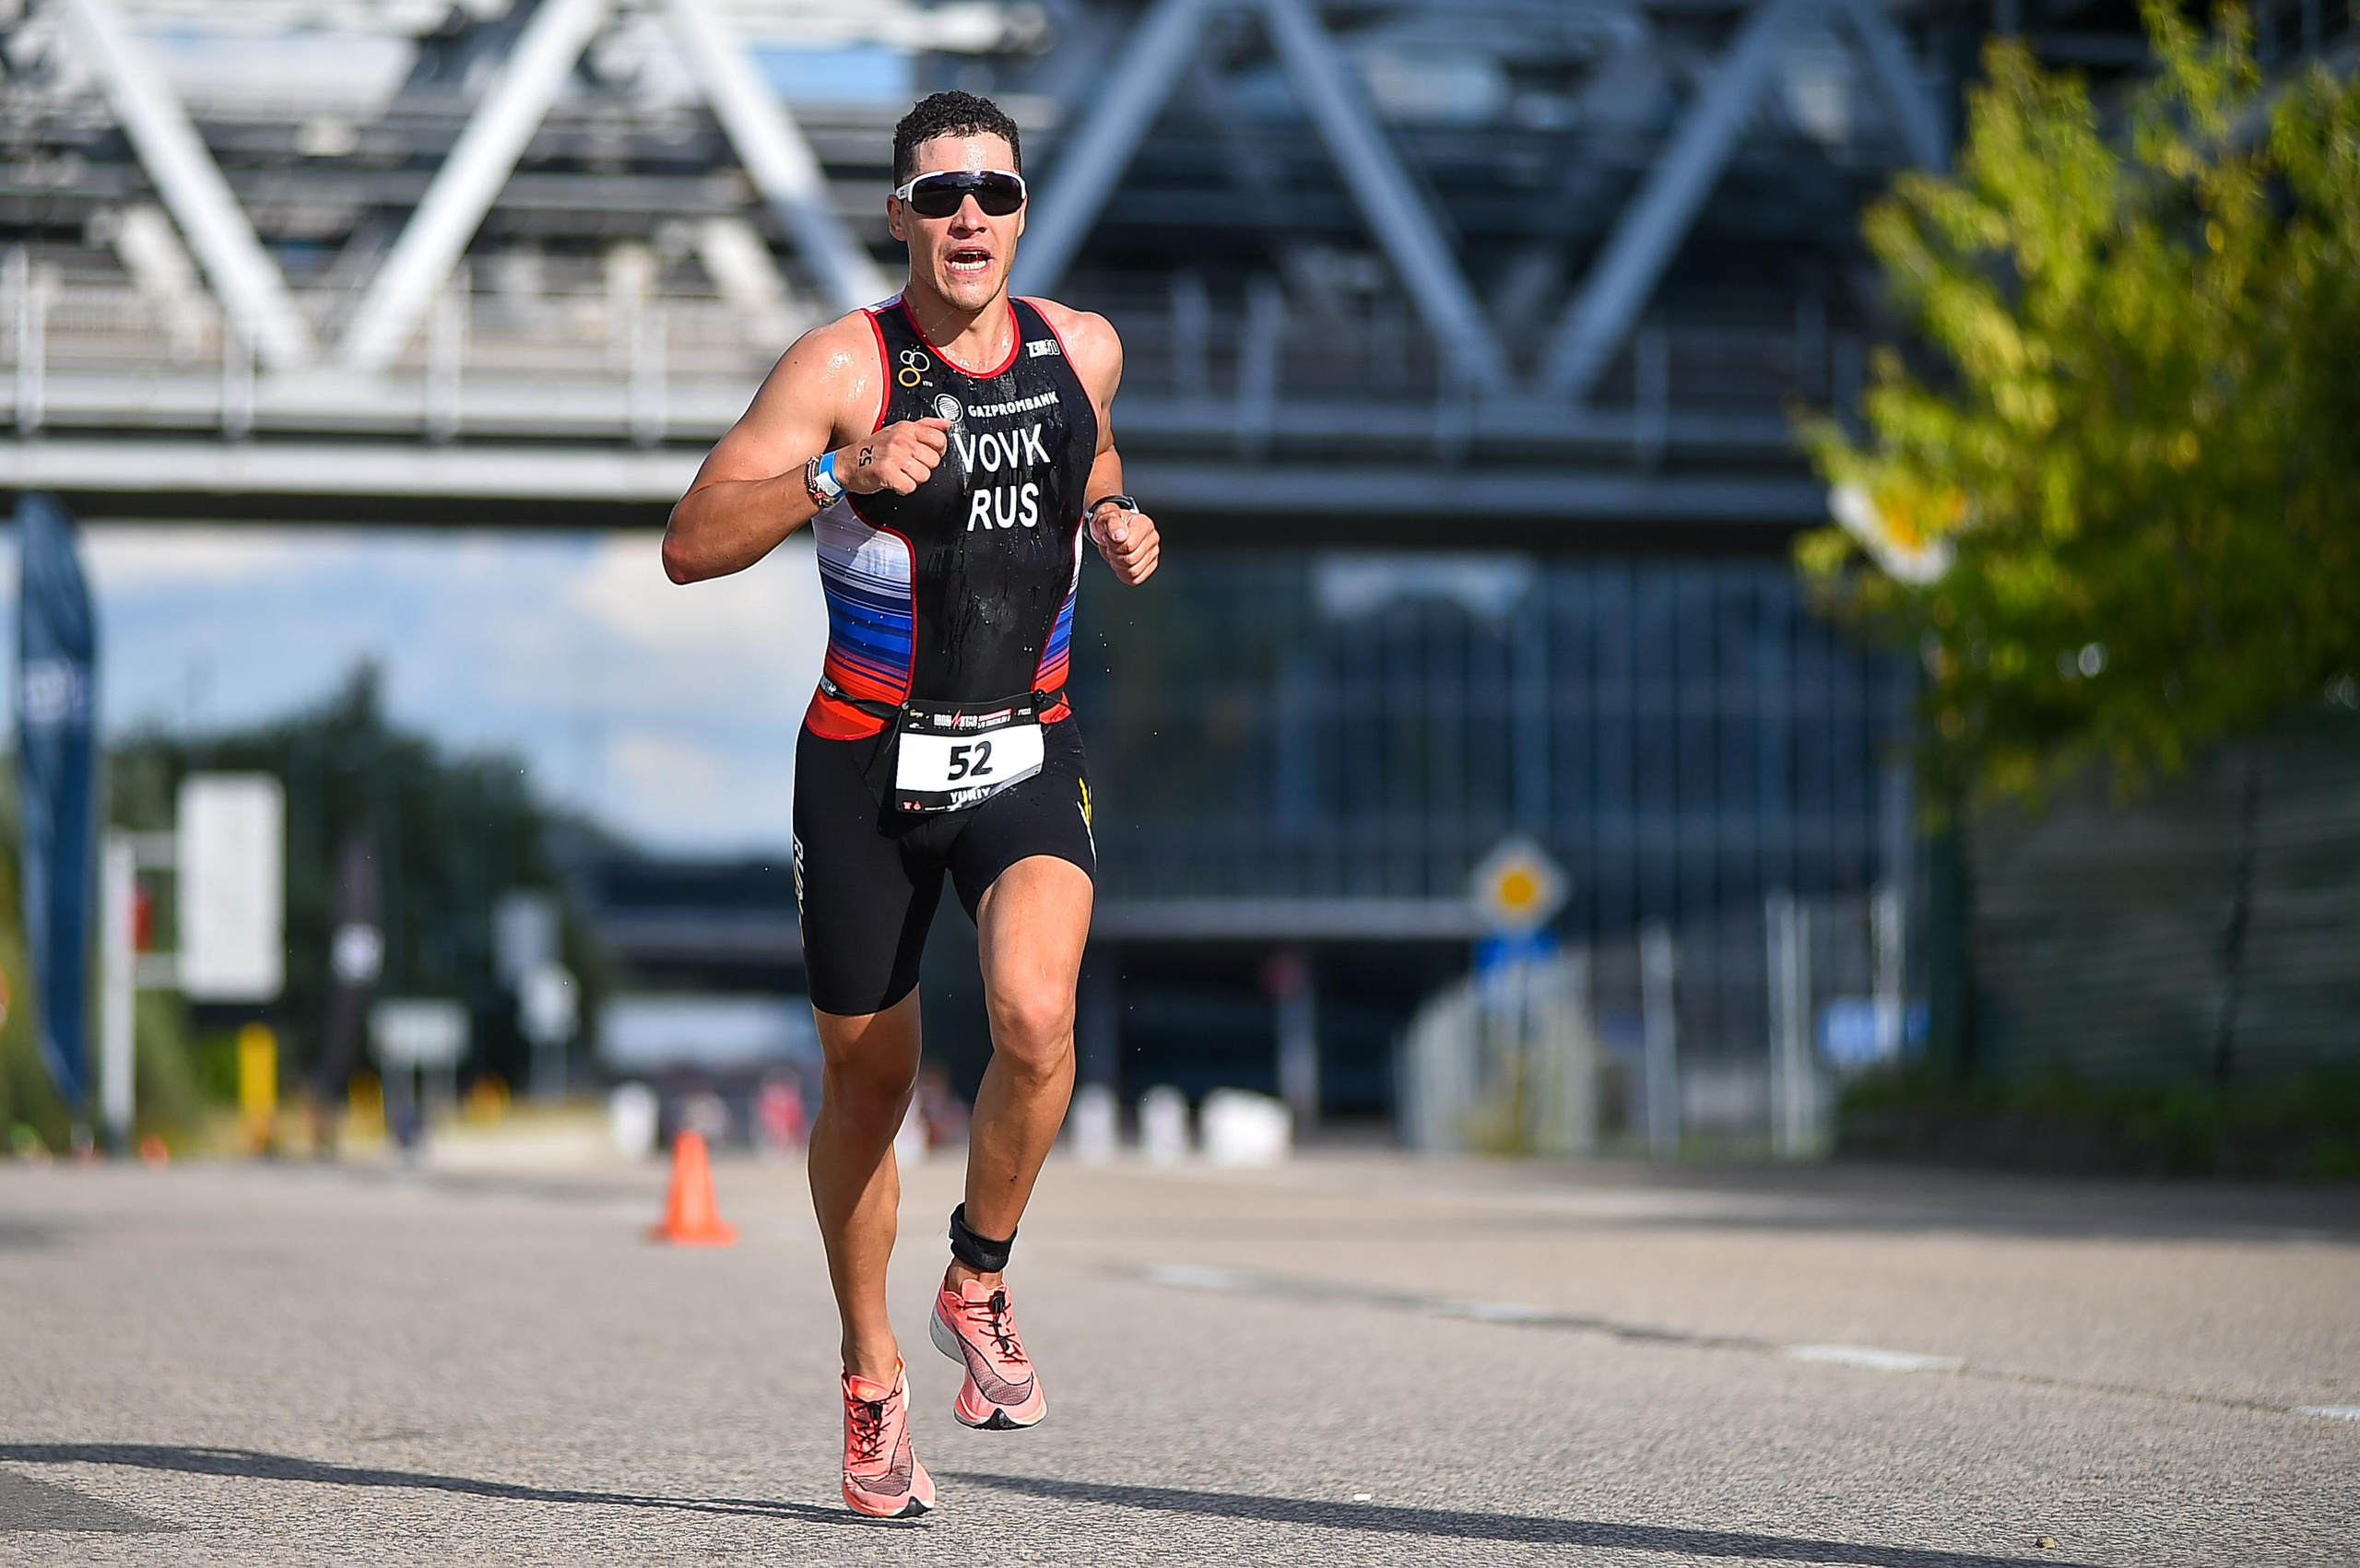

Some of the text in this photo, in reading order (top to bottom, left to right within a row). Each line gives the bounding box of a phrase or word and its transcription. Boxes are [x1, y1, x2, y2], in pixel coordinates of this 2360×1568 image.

[968, 391, 1059, 418] GAZPROMBANK
[859, 444, 873, 467] 52
[953, 423, 1051, 473] VOVK
[967, 482, 1039, 532] RUS
[948, 740, 993, 780] 52
[950, 787, 991, 803] YURIY
